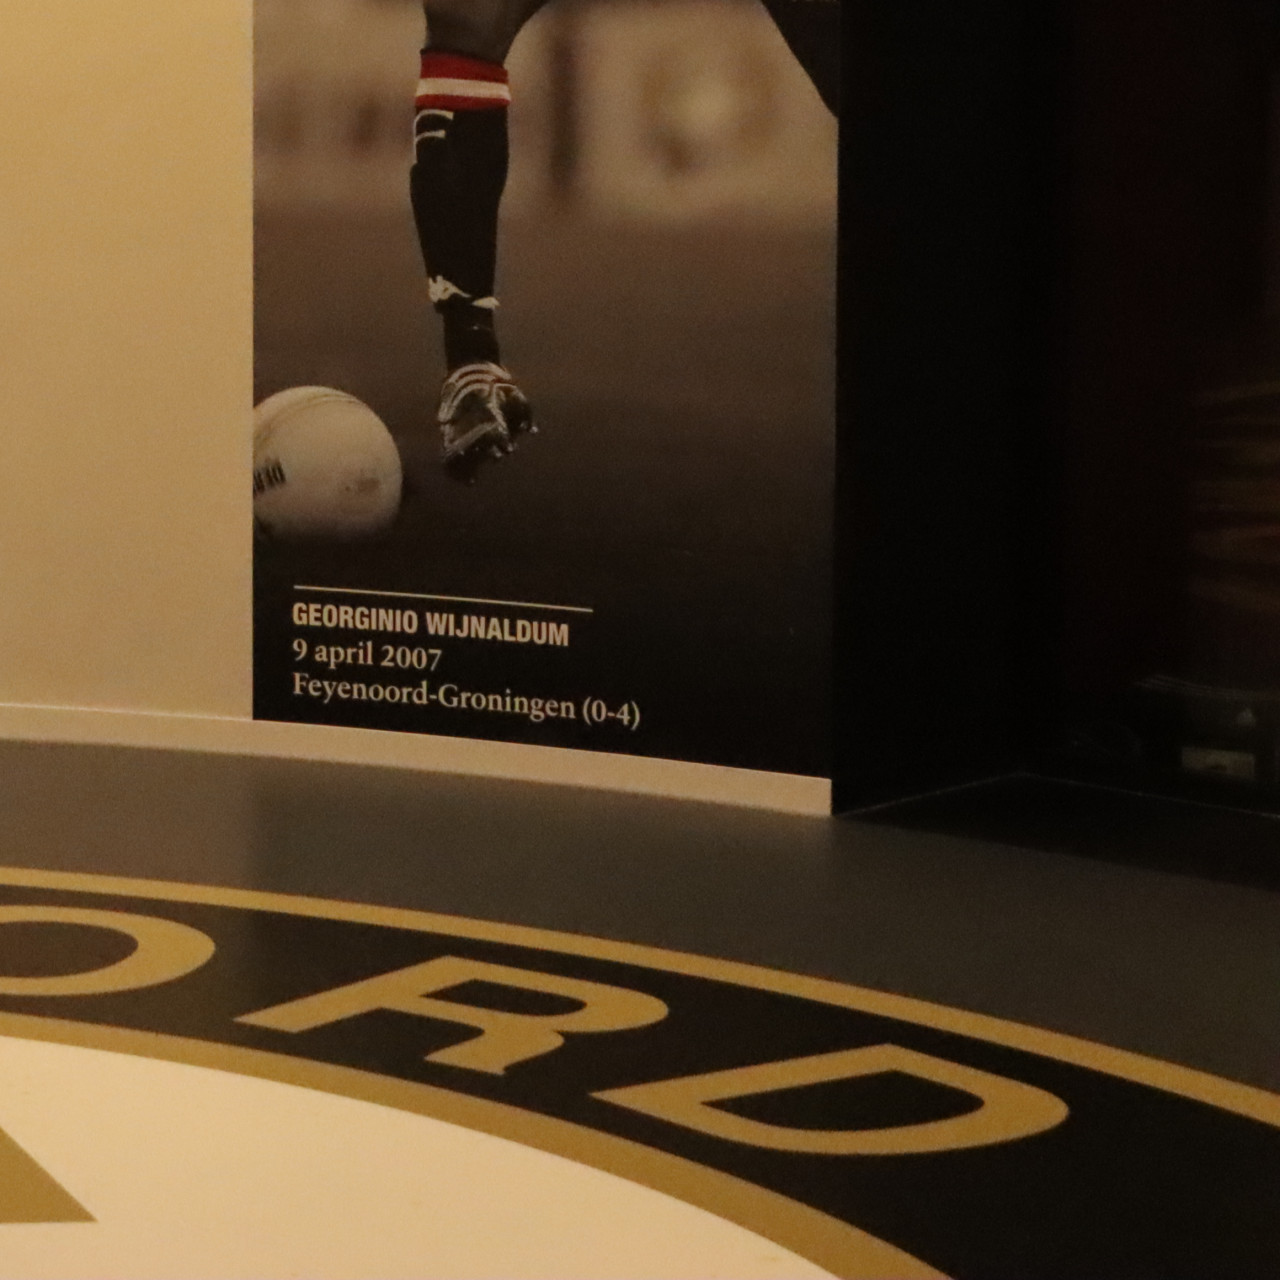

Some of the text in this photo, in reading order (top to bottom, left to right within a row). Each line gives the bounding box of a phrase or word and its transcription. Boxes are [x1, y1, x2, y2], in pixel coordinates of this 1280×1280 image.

[292, 602, 570, 647] GEORGINIO WIJNALDUM
[293, 638, 443, 671] 9 april 2007
[292, 672, 641, 731] Feyenoord-Groningen (0-4)
